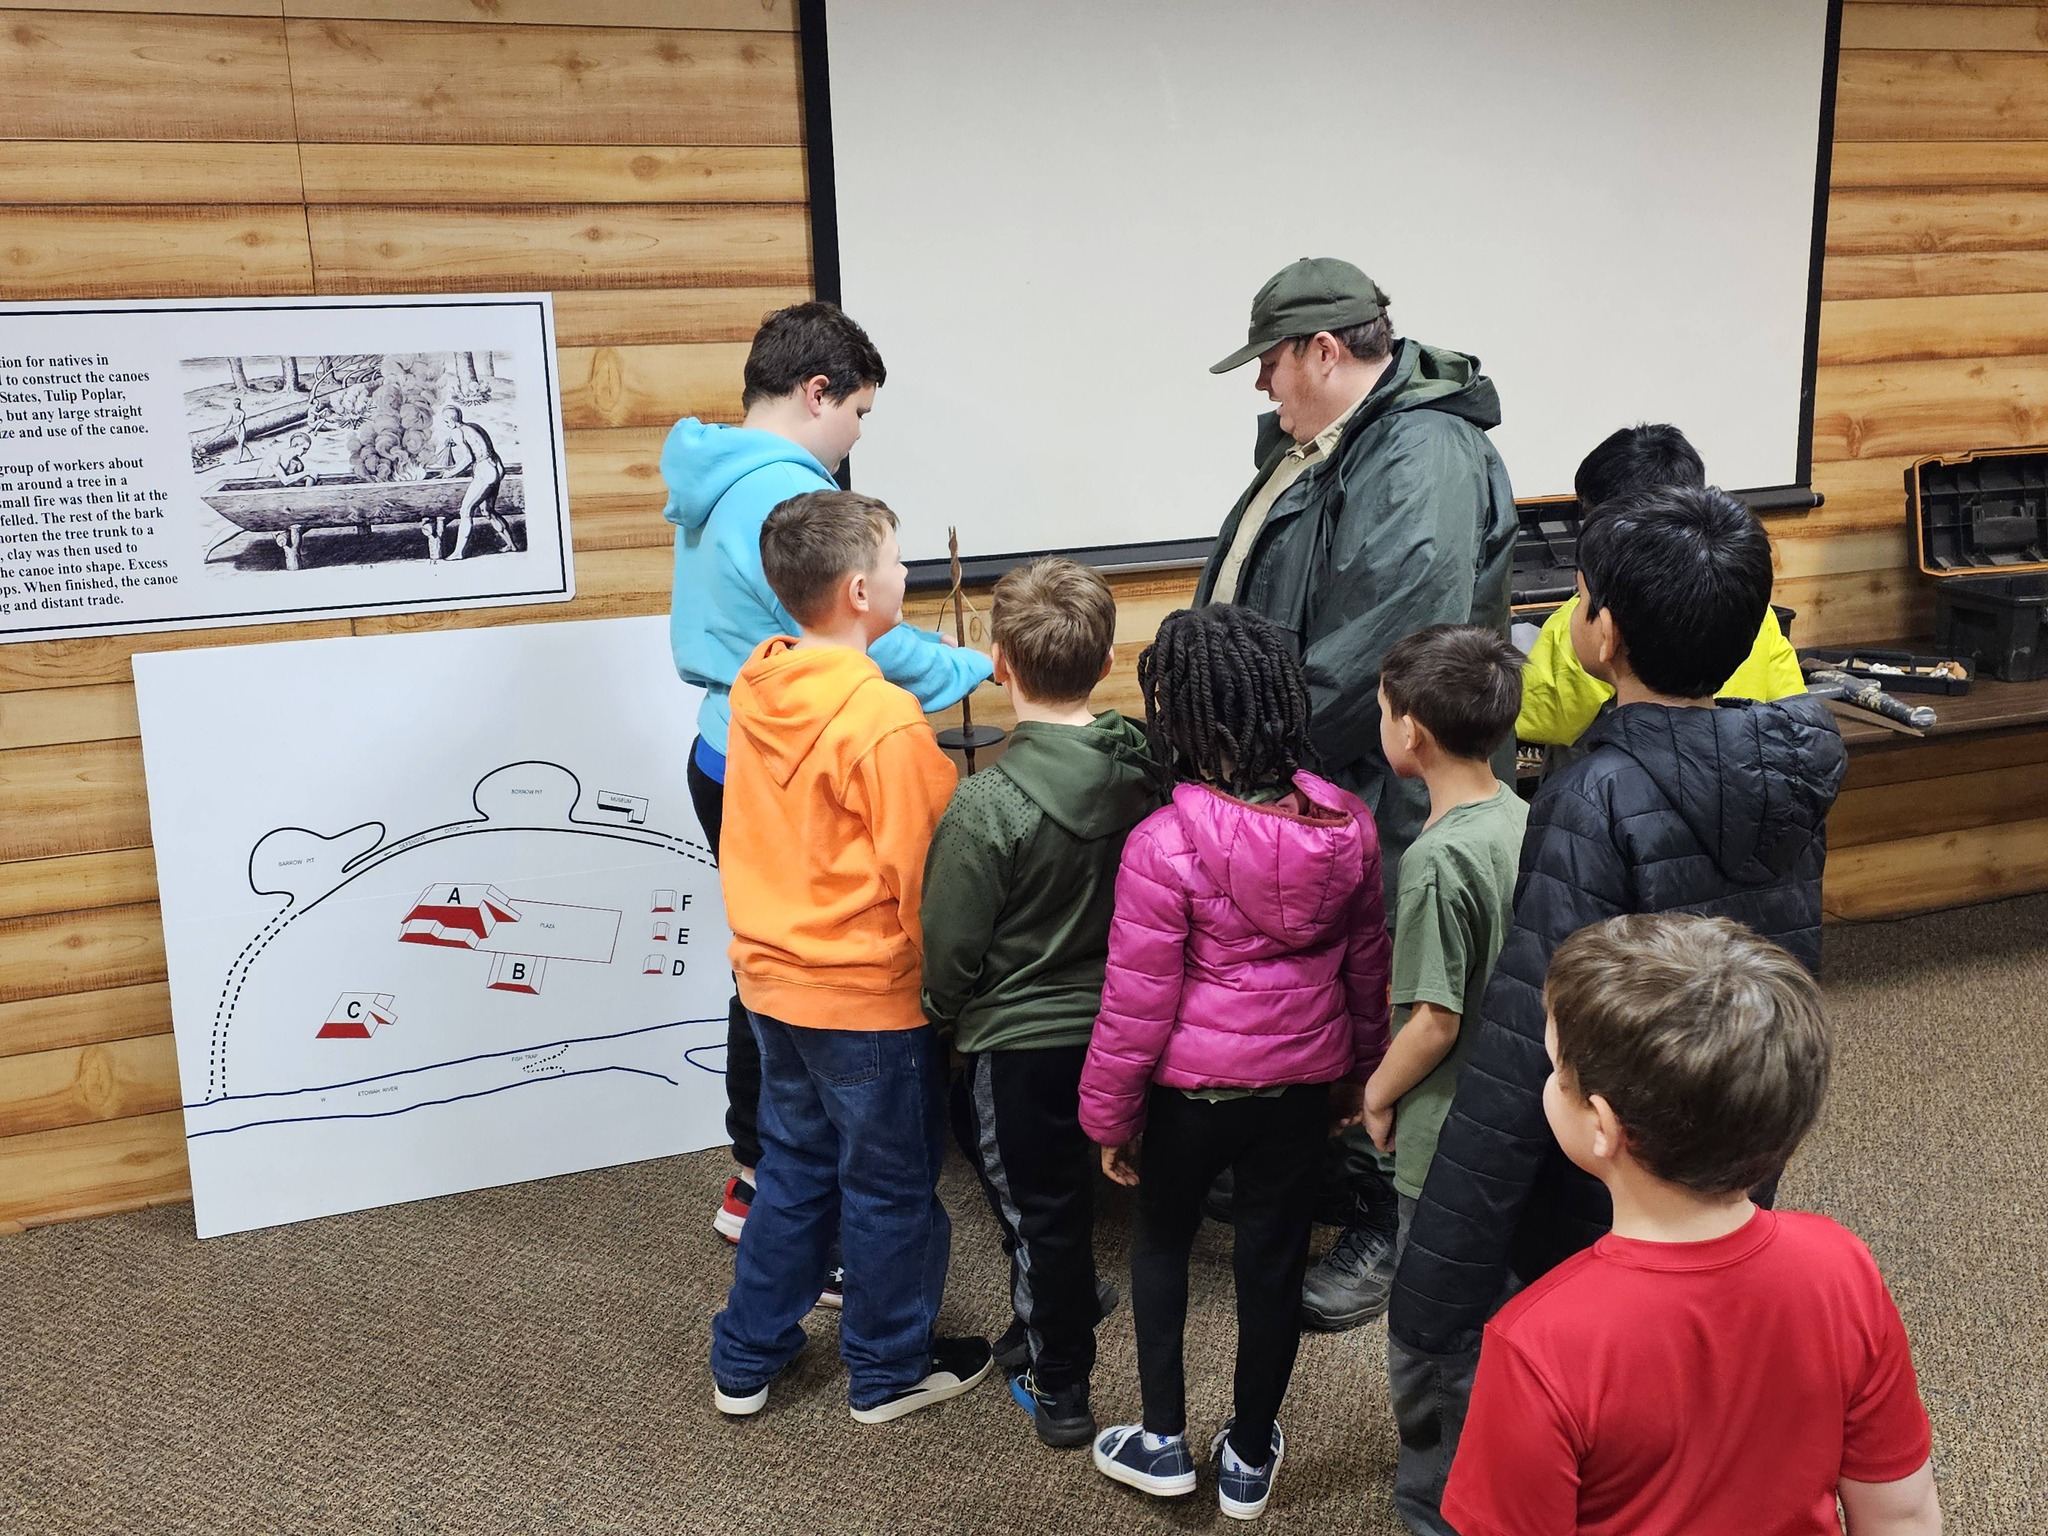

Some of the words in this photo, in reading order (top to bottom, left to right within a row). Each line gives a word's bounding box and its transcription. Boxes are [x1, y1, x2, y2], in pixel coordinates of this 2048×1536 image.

[0, 357, 22, 368] ion
[26, 356, 44, 367] for
[49, 355, 93, 366] natives
[97, 354, 108, 365] in
[6, 376, 18, 385] to
[23, 373, 81, 385] construct
[85, 371, 104, 382] the
[109, 373, 149, 382] canoes
[0, 392, 41, 403] States,
[44, 390, 77, 404] Tulip
[81, 388, 125, 403] Poplar,
[6, 410, 28, 421] but
[32, 411, 54, 423] any
[58, 408, 90, 421] large
[94, 405, 142, 420] straight
[19, 426, 42, 438] and
[47, 428, 66, 436] use
[71, 424, 83, 436] of
[87, 424, 105, 435] the
[110, 425, 148, 434] canoe.
[38, 460, 50, 472] of
[53, 459, 104, 471] workers
[109, 458, 143, 469] about
[17, 477, 62, 490] around
[67, 480, 73, 488] a
[77, 478, 101, 487] tree
[105, 475, 116, 486] in
[121, 477, 127, 485] a
[34, 496, 55, 507] fire
[59, 496, 82, 505] was
[86, 493, 113, 504] then
[117, 491, 130, 502] lit
[134, 492, 145, 501] at
[149, 490, 167, 500] the
[1, 514, 38, 526] felled.
[41, 512, 65, 524] The
[70, 512, 92, 522] rest
[97, 509, 108, 521] of
[112, 509, 130, 520] the
[135, 507, 164, 519] bark
[42, 530, 61, 541] the
[65, 530, 88, 539] tree
[93, 526, 128, 537] trunk
[132, 526, 143, 535] to
[8, 549, 31, 562] clay
[36, 549, 59, 557] was
[64, 545, 90, 556] then
[95, 542, 122, 554] used
[126, 543, 137, 552] to
[19, 567, 54, 577] canoe
[58, 564, 82, 574] into
[86, 561, 124, 574] shape.
[129, 559, 167, 570] Excess
[24, 581, 61, 592] When
[65, 577, 118, 590] finished,
[121, 576, 140, 586] the
[144, 576, 178, 585] canoe
[14, 599, 37, 611] and
[42, 597, 83, 609] distant
[88, 594, 123, 605] trade.
[444, 826, 460, 834] DITCH
[447, 887, 461, 905] A
[682, 894, 692, 912] F
[677, 927, 690, 945] E
[512, 963, 526, 980] B
[671, 959, 686, 976] D
[346, 1001, 361, 1019] C
[382, 1085, 399, 1093] RIVER
